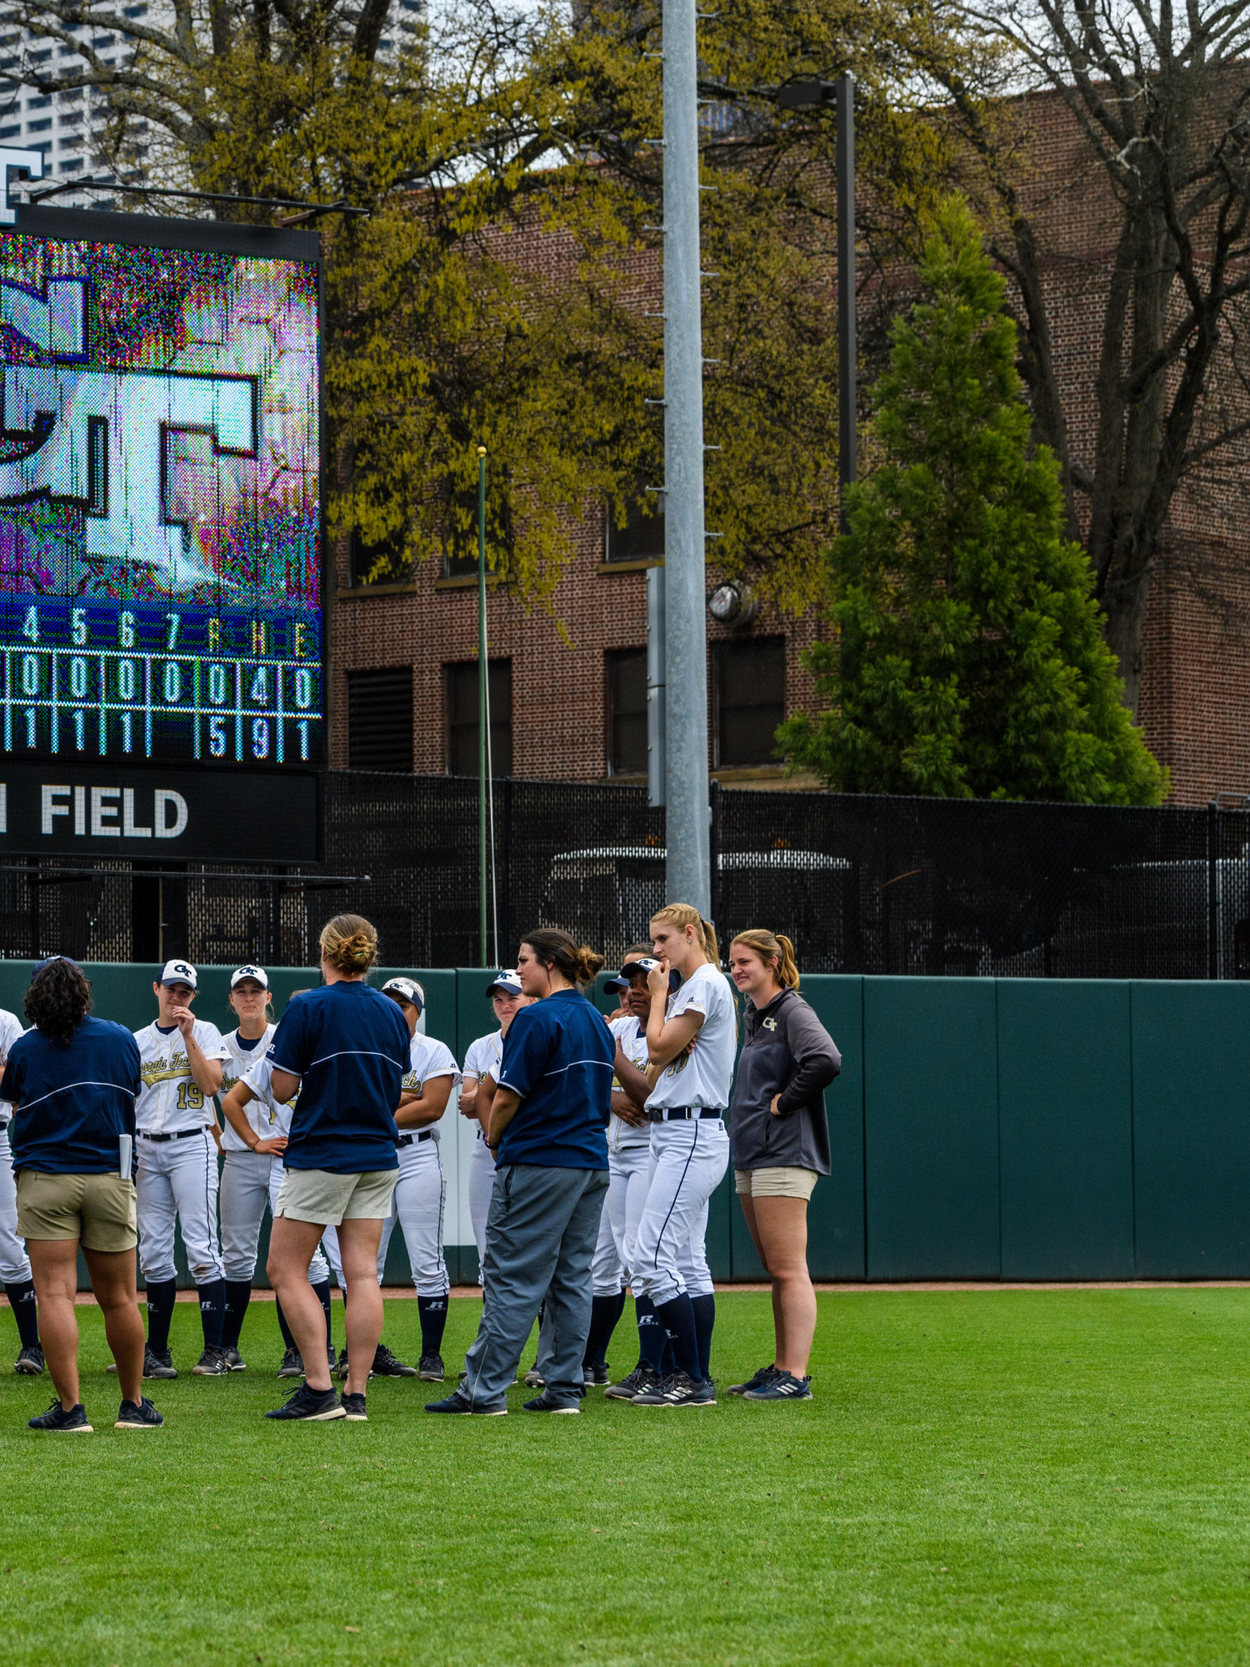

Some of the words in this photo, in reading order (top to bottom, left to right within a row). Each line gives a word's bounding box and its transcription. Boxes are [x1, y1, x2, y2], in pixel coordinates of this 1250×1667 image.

[23, 605, 40, 642] 4
[72, 608, 87, 646] 5
[120, 611, 135, 648] 6
[165, 613, 181, 650] 7
[208, 618, 222, 652] R
[252, 620, 266, 654] H
[295, 622, 308, 657] E
[22, 654, 39, 696] 0
[71, 656, 87, 699] 0
[118, 659, 134, 701] 0
[164, 661, 181, 703] 0
[209, 663, 226, 705] 0
[251, 665, 268, 707] 4
[295, 668, 311, 710] 0
[24, 707, 37, 749] 1
[73, 709, 85, 752] 1
[120, 711, 132, 754] 1
[210, 716, 227, 758] 5
[251, 718, 269, 760] 9
[297, 720, 309, 761] 1
[41, 784, 189, 839] FIELD
[174, 964, 192, 978] GT
[762, 1017, 778, 1032] GT
[176, 1082, 204, 1110] 19
[402, 1070, 418, 1087] ch
